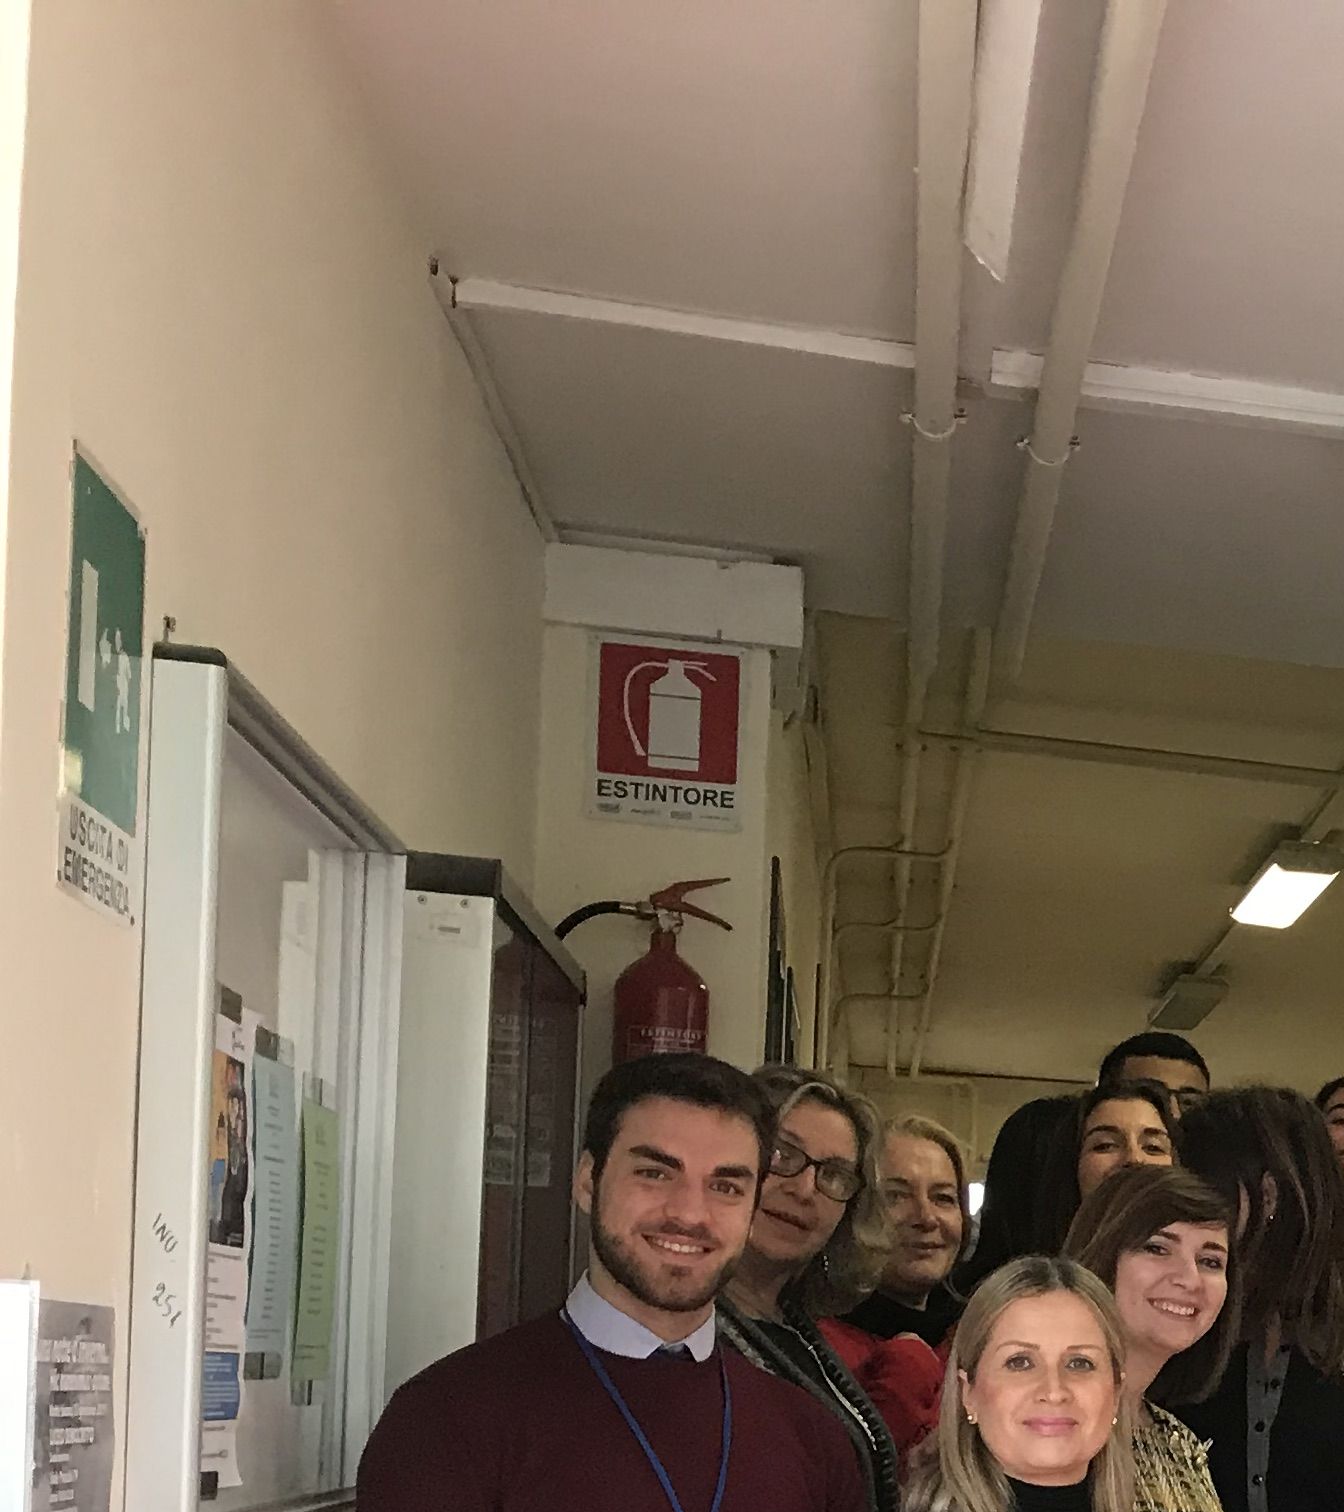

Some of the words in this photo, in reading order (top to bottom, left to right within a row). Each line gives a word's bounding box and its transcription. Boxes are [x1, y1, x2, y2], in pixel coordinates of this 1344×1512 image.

[597, 778, 735, 809] ESTINTORE
[70, 803, 113, 865] USCITA
[64, 846, 129, 915] EMERGENZA
